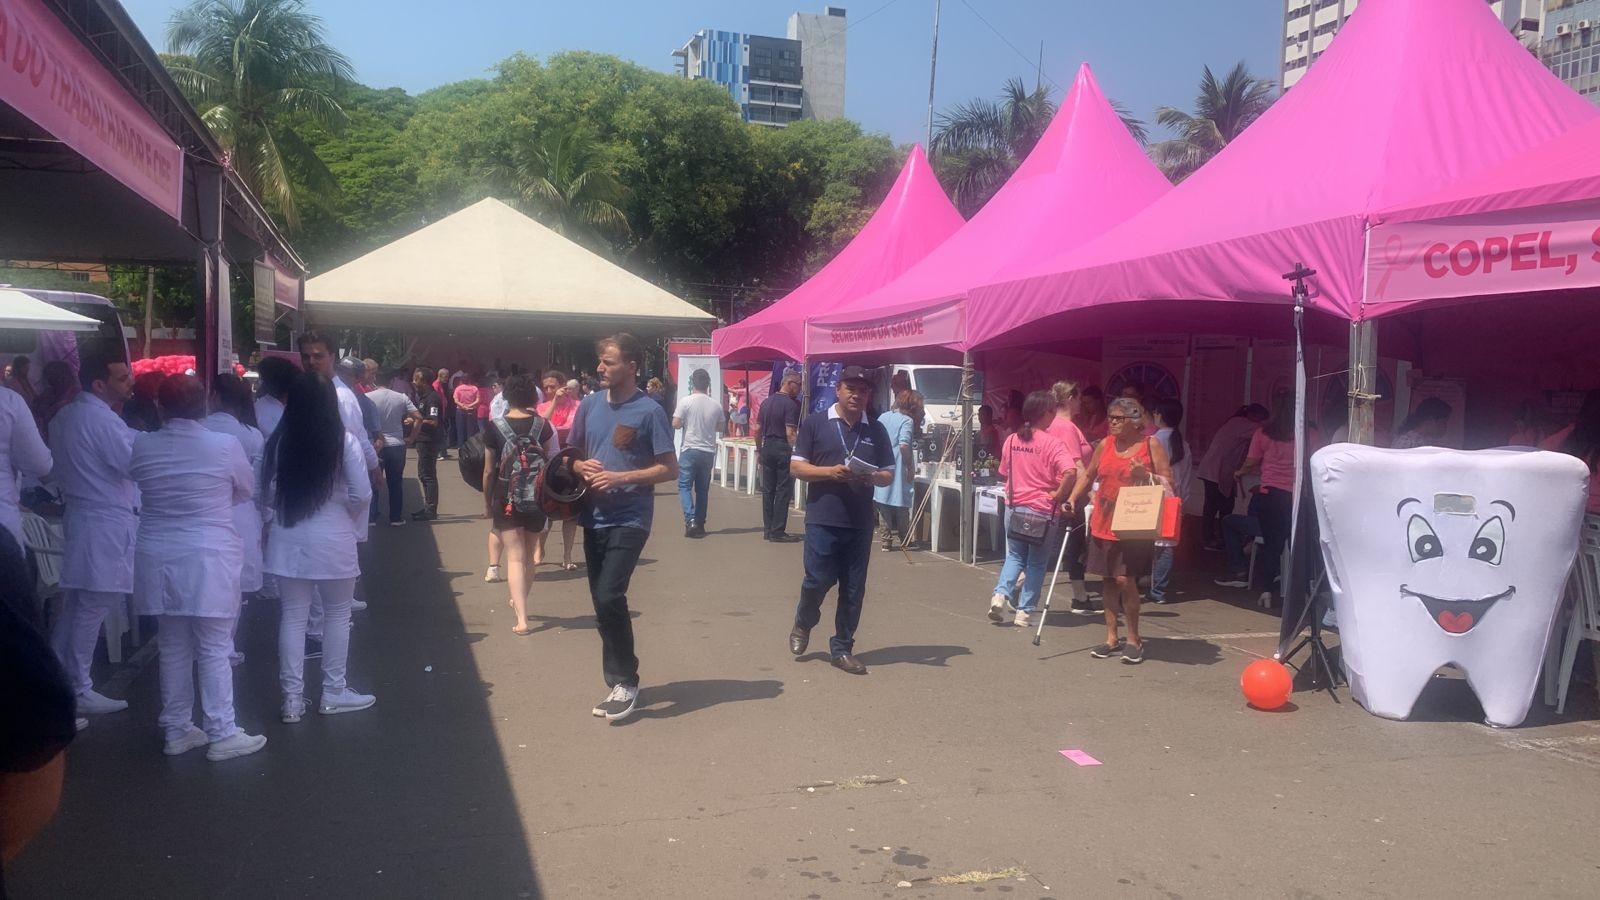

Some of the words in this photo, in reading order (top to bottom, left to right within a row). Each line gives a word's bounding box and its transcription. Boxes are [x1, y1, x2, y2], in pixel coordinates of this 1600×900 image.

[12, 16, 46, 87] DO
[46, 49, 145, 172] TRABALHADOR
[1424, 230, 1578, 279] COPEL,
